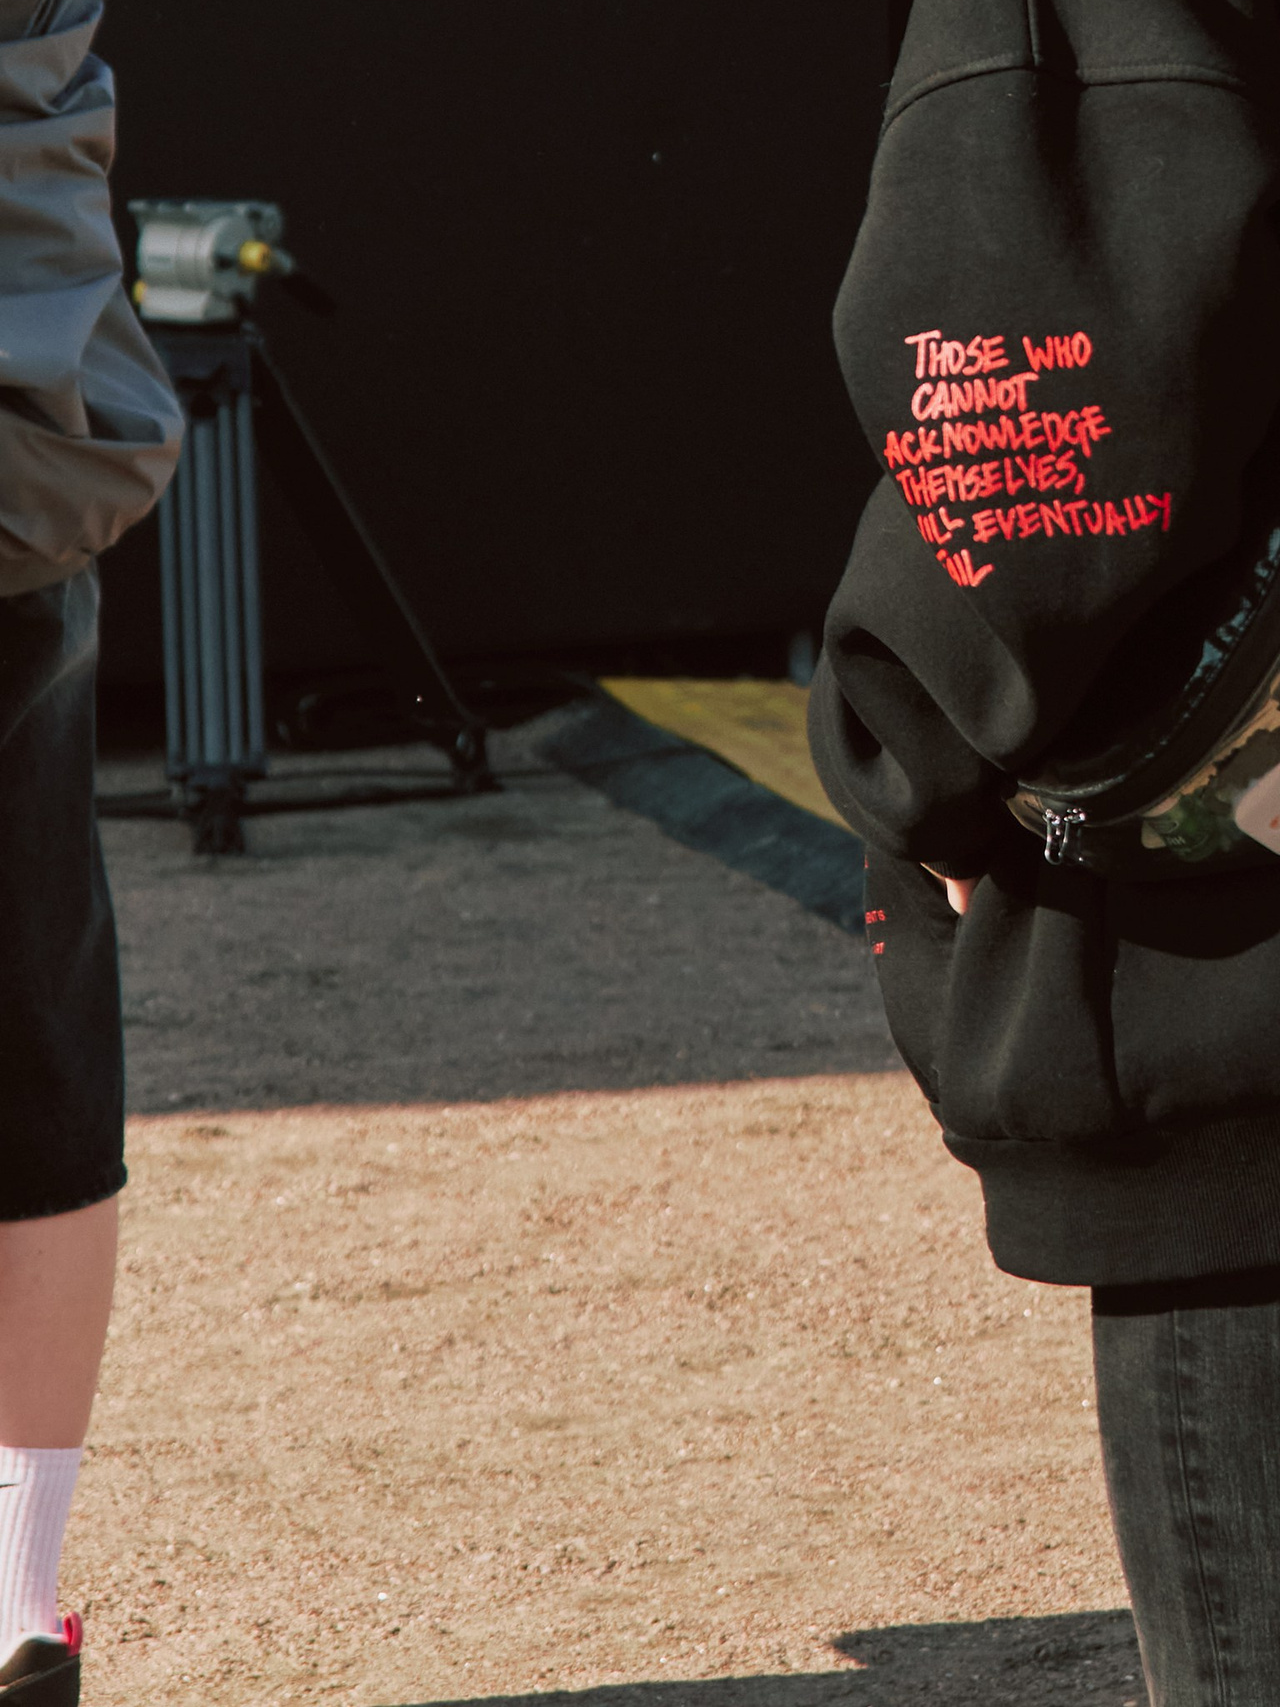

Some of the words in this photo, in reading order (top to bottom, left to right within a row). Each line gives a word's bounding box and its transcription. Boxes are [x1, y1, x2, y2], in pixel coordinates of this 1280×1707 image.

[905, 329, 1009, 379] THOSE
[1022, 330, 1093, 373] WHO
[911, 372, 1039, 421] CANNOT
[884, 405, 1111, 468] ACKNOWLEDGE
[896, 449, 1085, 507] THEMSELVES,
[972, 492, 1172, 543] EVENTUALLY
